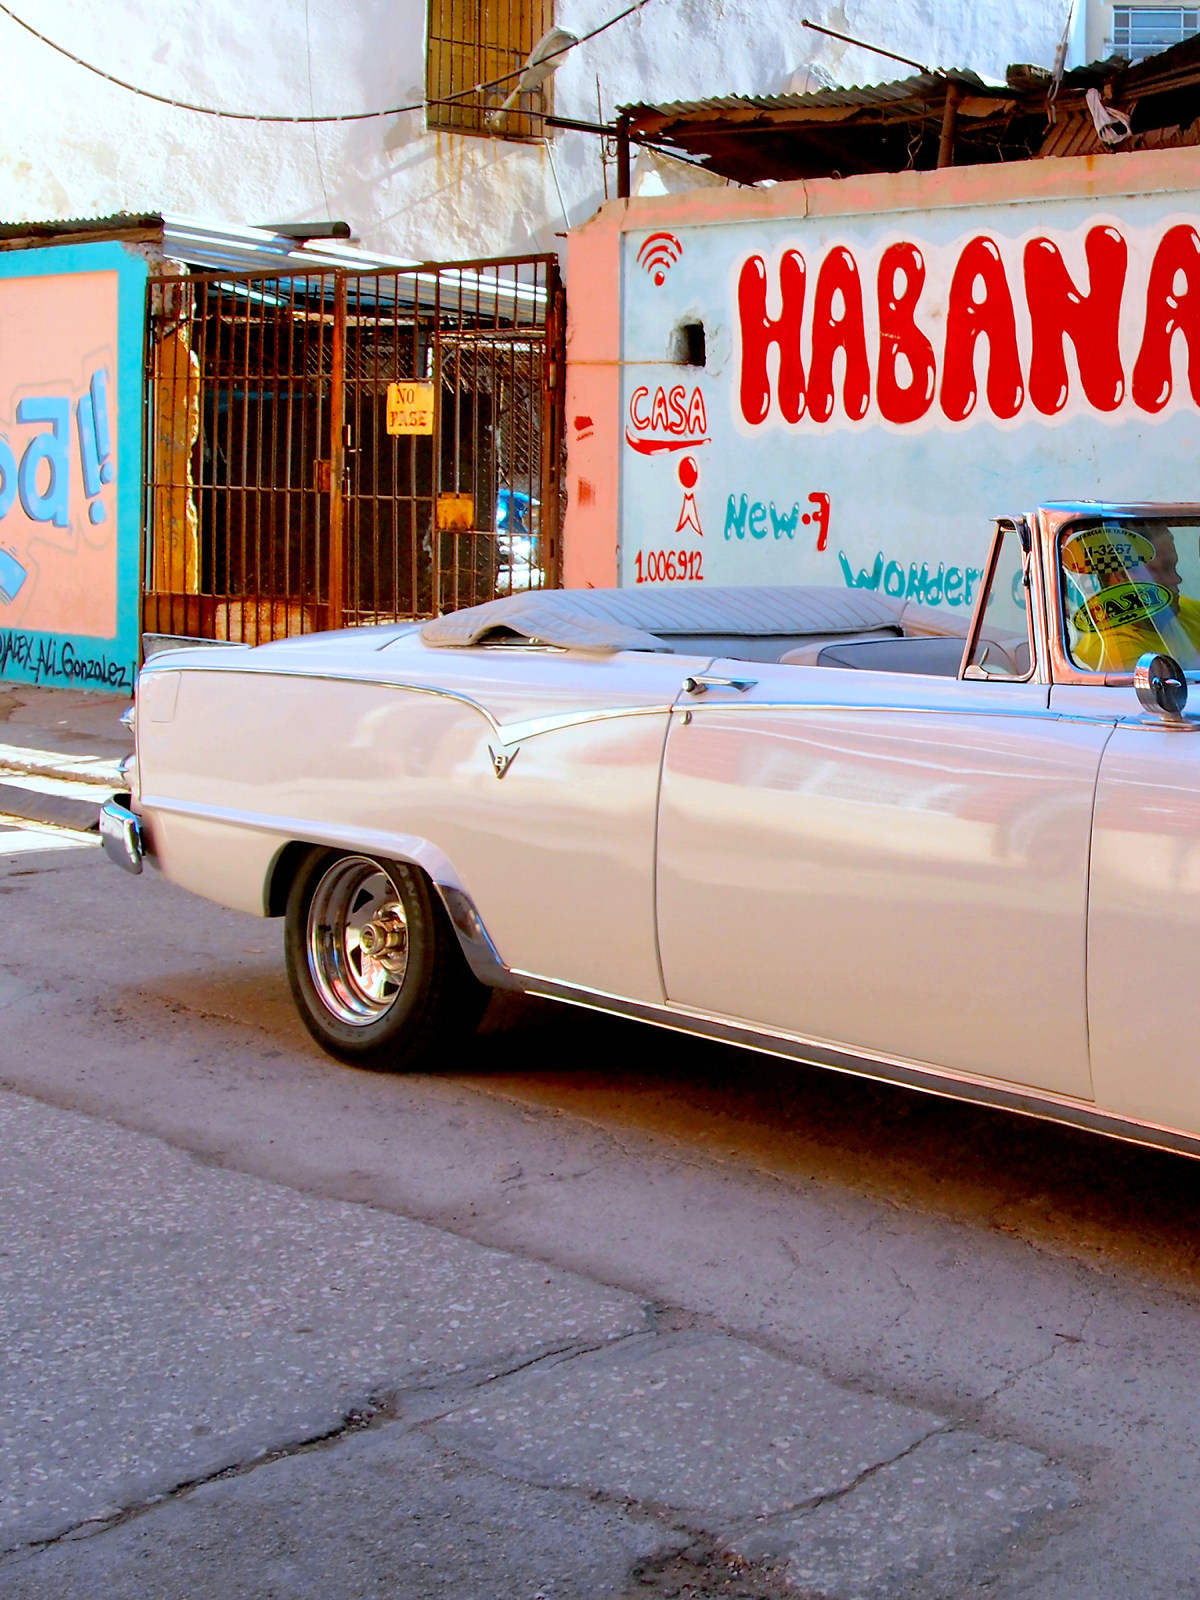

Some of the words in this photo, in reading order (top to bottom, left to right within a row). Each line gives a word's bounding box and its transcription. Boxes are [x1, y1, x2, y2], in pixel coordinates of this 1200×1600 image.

[397, 388, 415, 404] NO
[630, 385, 707, 434] CASA
[1082, 586, 1163, 628] TAXI
